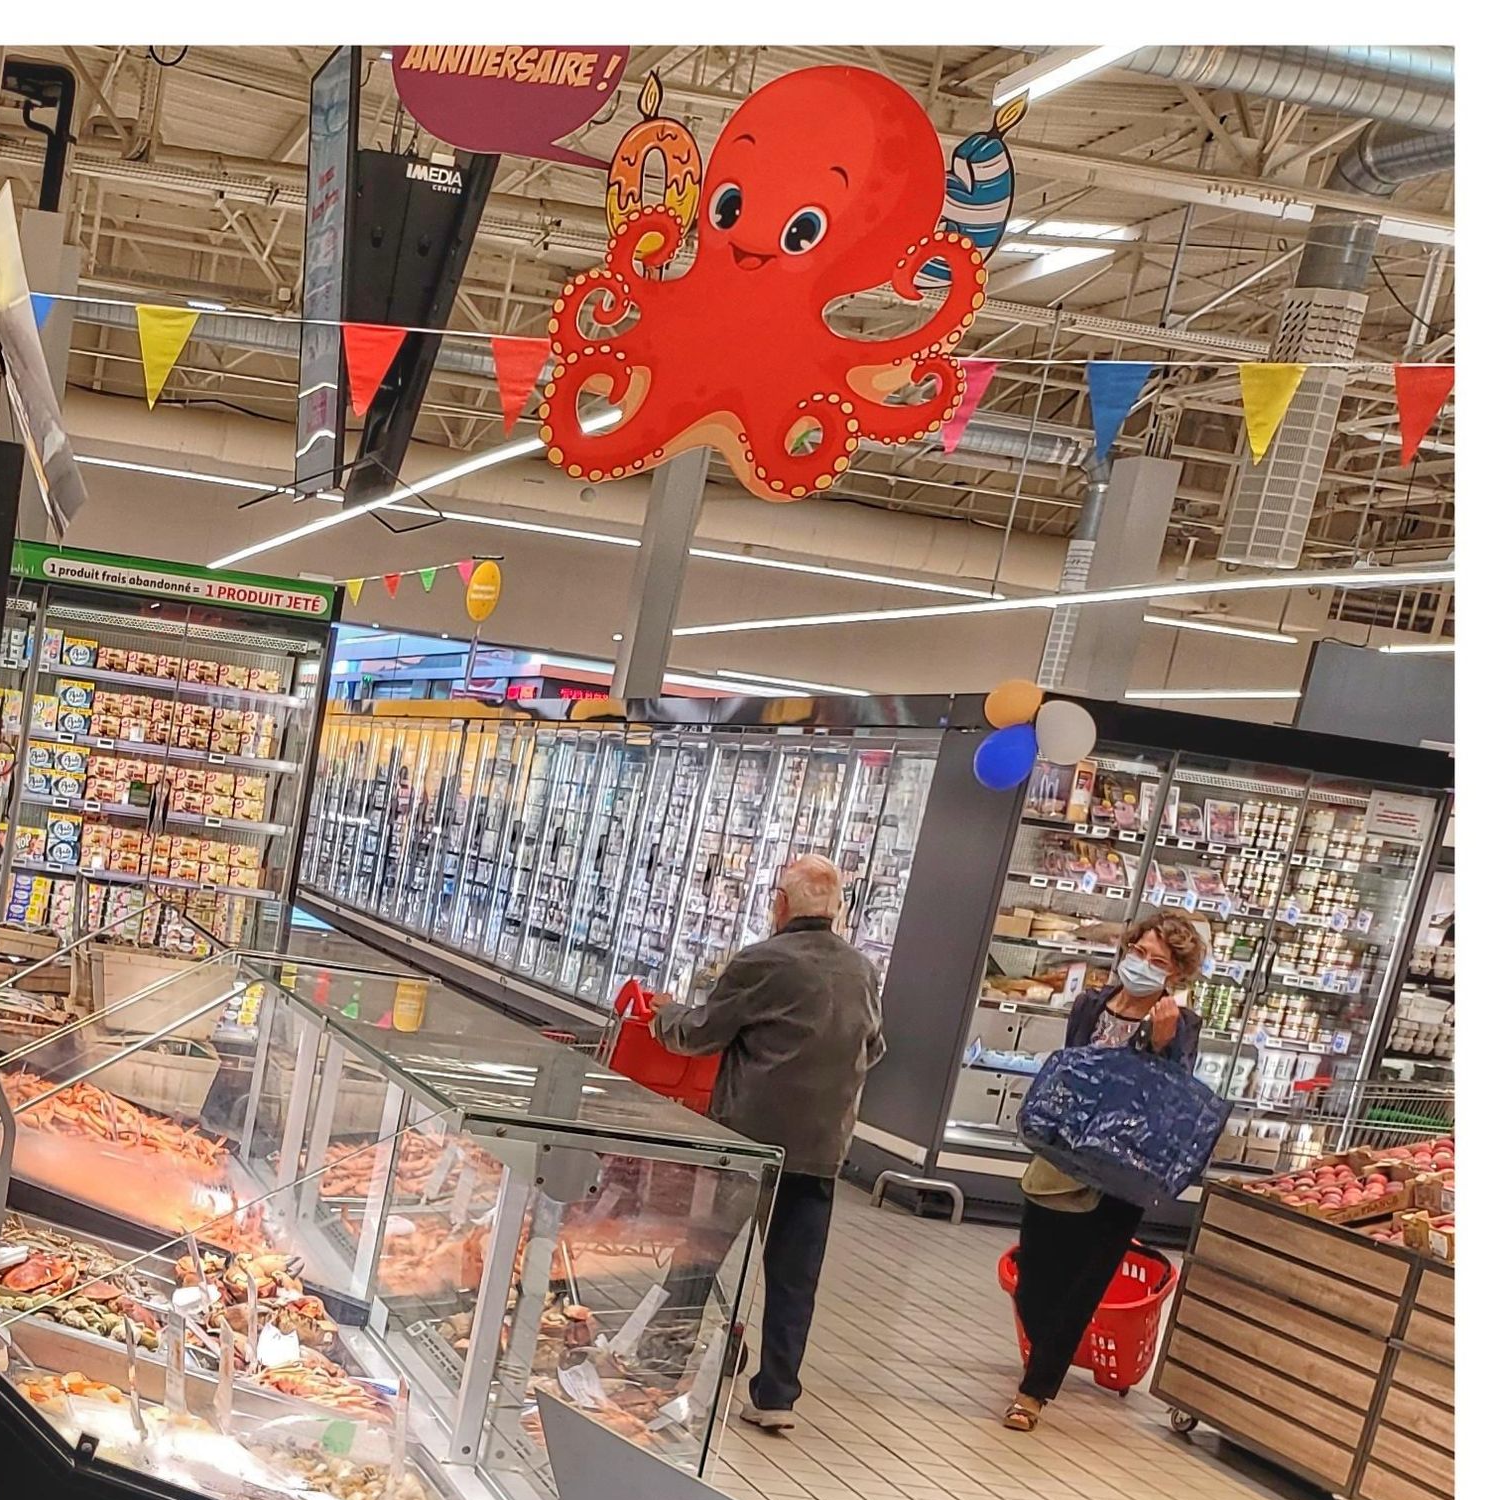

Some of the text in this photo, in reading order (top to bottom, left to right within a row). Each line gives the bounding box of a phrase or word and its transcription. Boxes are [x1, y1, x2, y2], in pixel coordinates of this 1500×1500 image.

[401, 45, 599, 87] ANNIVERSAIRE
[431, 184, 463, 195] CENTER
[48, 562, 57, 574] 1
[58, 564, 101, 583] produit
[101, 570, 127, 586] frais
[128, 573, 192, 594] abandonné
[205, 584, 214, 597] 1
[216, 586, 283, 607] PRODUIT
[285, 594, 321, 612] JETÉ
